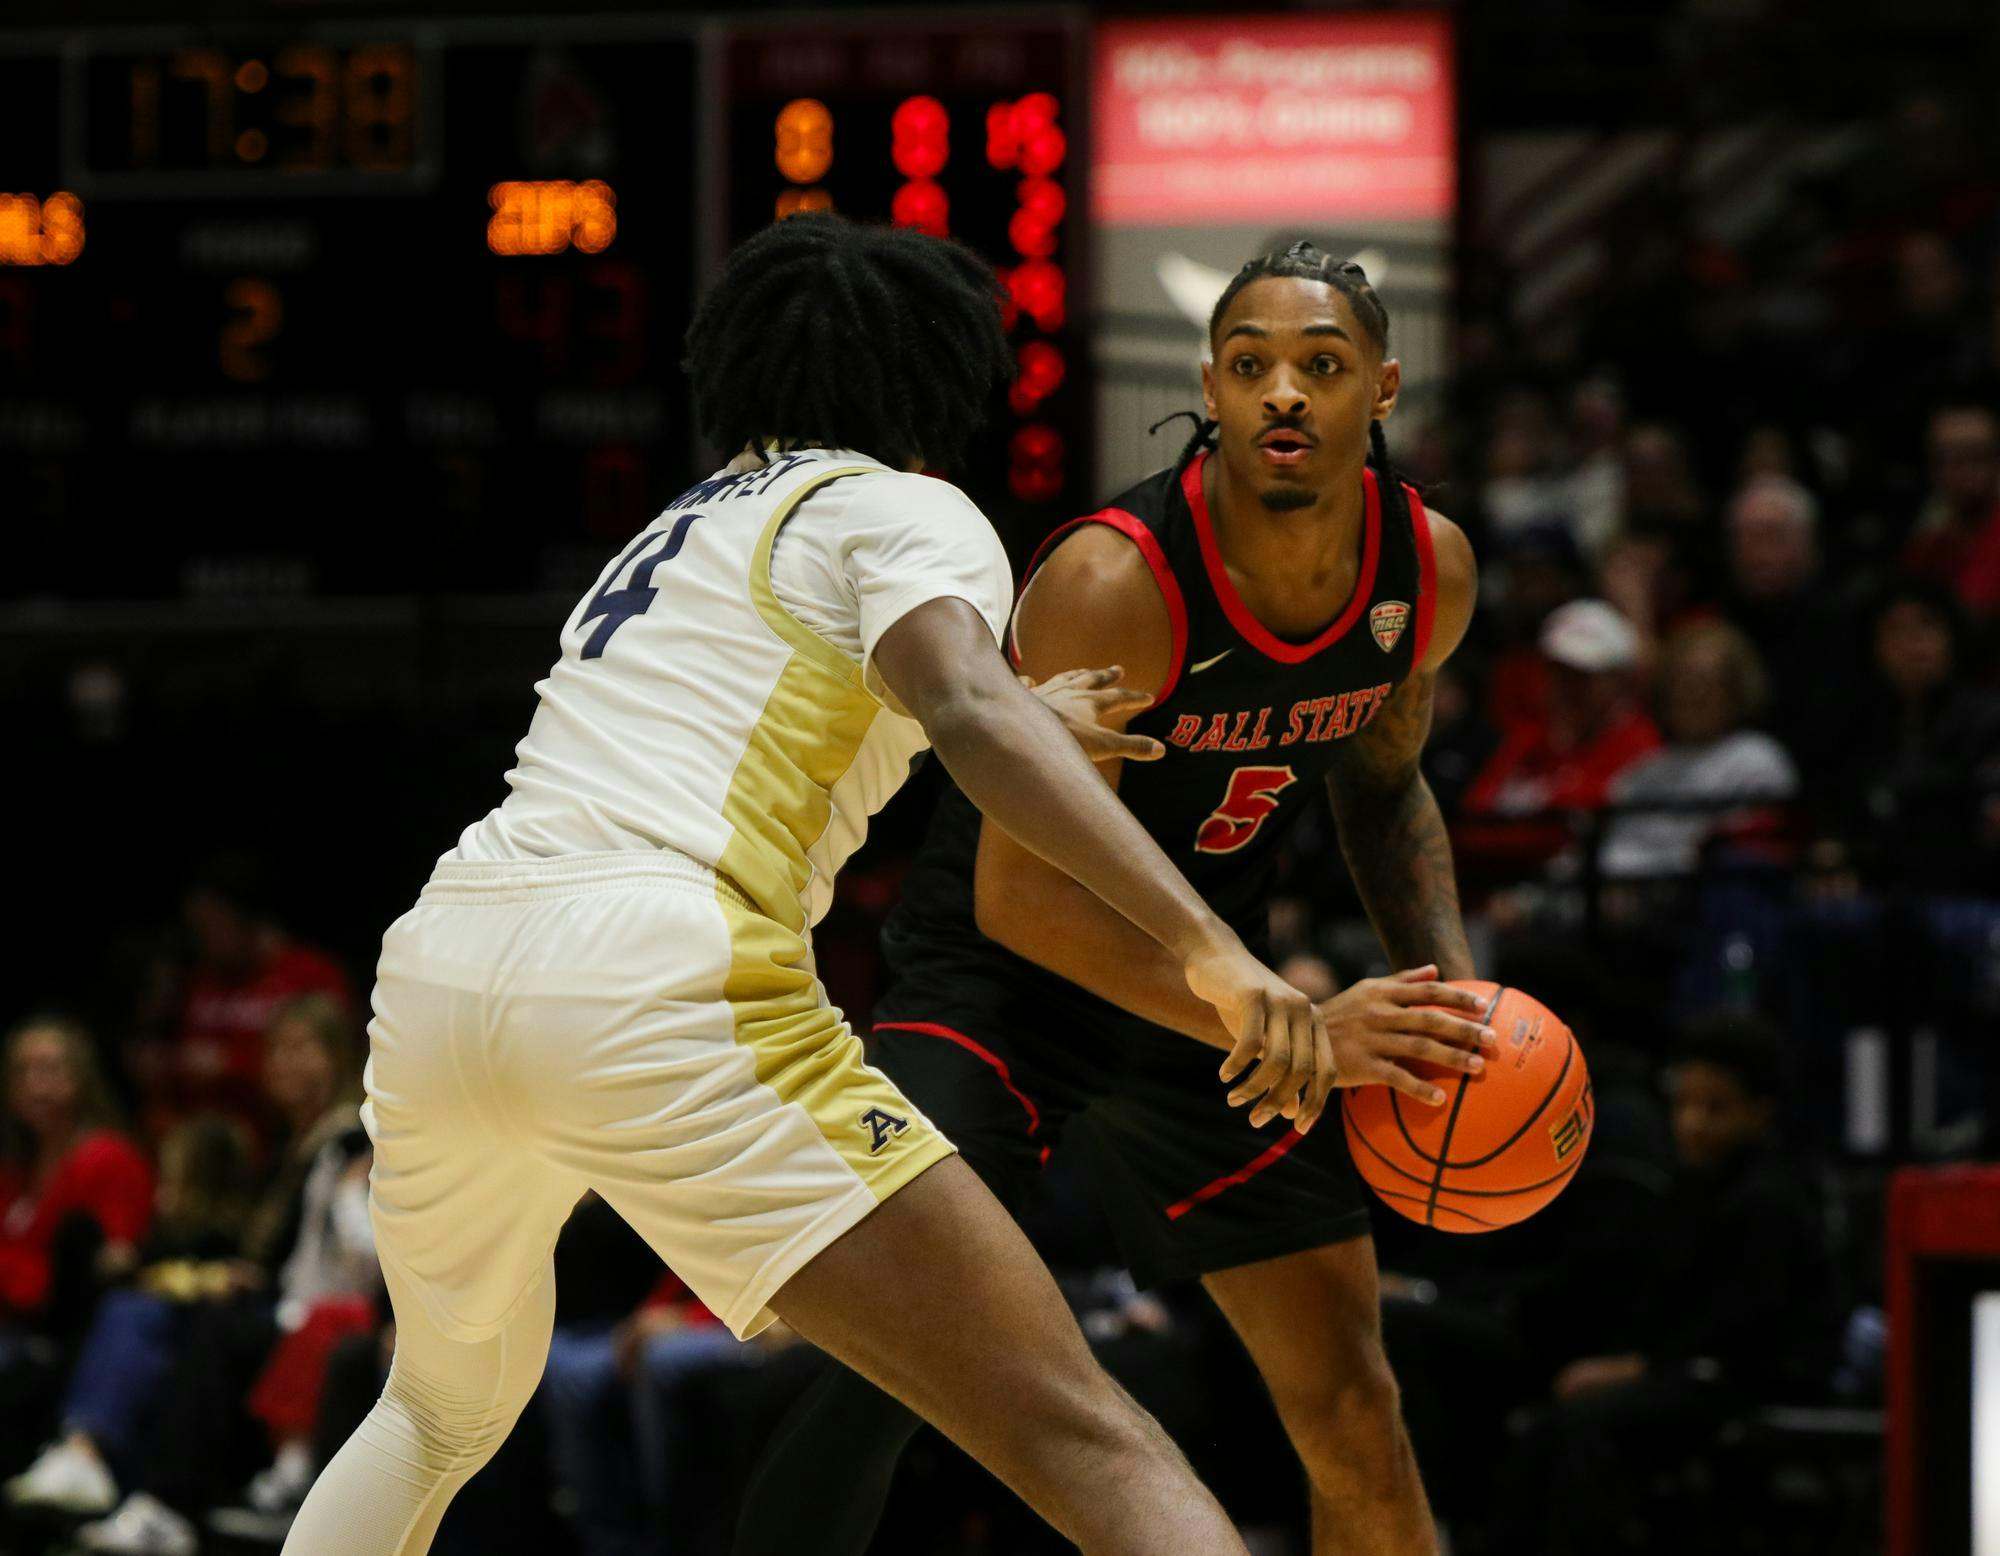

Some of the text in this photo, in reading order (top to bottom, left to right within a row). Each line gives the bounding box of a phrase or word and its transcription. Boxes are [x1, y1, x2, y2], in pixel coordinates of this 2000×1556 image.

[128, 44, 416, 172] 17:38
[217, 274, 286, 384] 2
[573, 513, 707, 661] 4
[1165, 706, 1273, 752] BALL
[1194, 765, 1298, 855] 5
[858, 1105, 912, 1157] A
